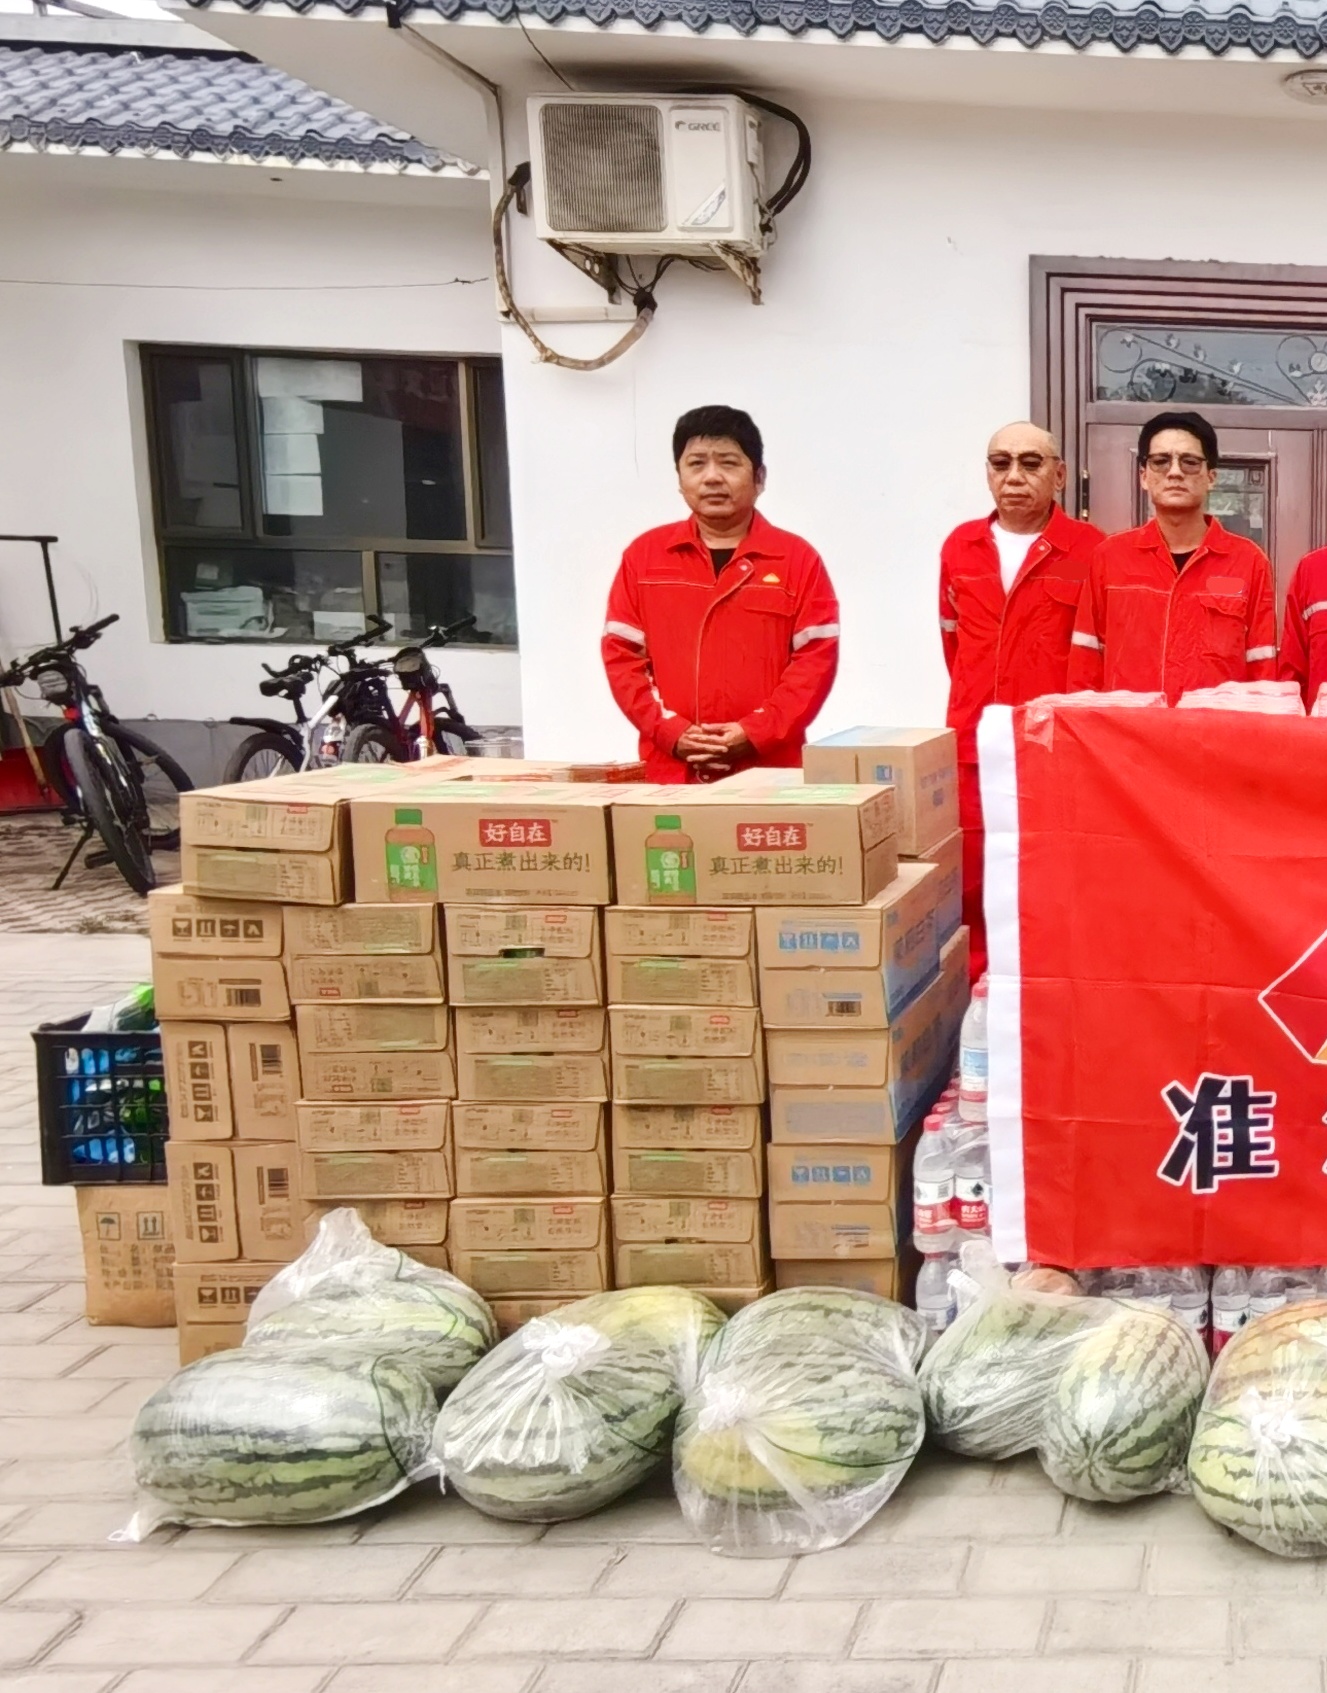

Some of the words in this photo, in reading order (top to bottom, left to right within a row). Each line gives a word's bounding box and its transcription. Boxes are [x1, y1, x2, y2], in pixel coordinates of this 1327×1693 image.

[484, 822, 547, 843] 好自在
[741, 826, 802, 847] 好自在
